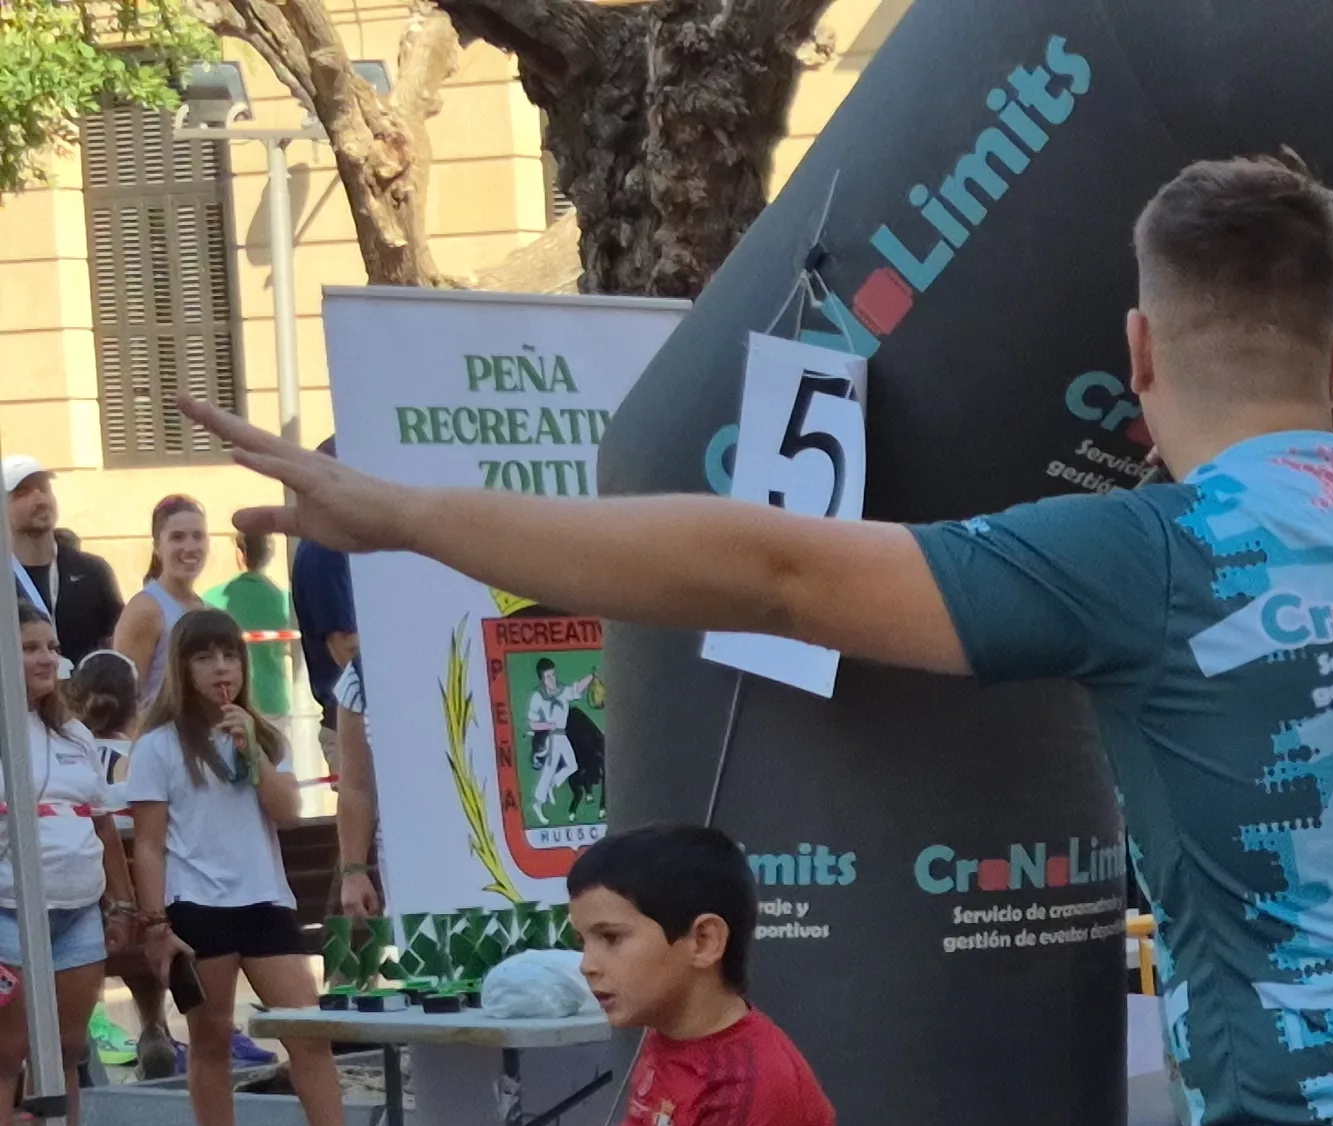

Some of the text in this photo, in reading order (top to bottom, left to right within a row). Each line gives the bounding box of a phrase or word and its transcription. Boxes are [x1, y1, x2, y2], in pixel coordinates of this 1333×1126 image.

[463, 343, 579, 392] PEÑA
[495, 619, 603, 645] RECREATI
[540, 828, 604, 843] HUESC
[796, 902, 809, 918] y
[953, 904, 1023, 924] Servicio
[1026, 903, 1046, 920] de
[755, 921, 830, 940] portivos
[943, 929, 1011, 953] gestión
[1014, 928, 1037, 946] de
